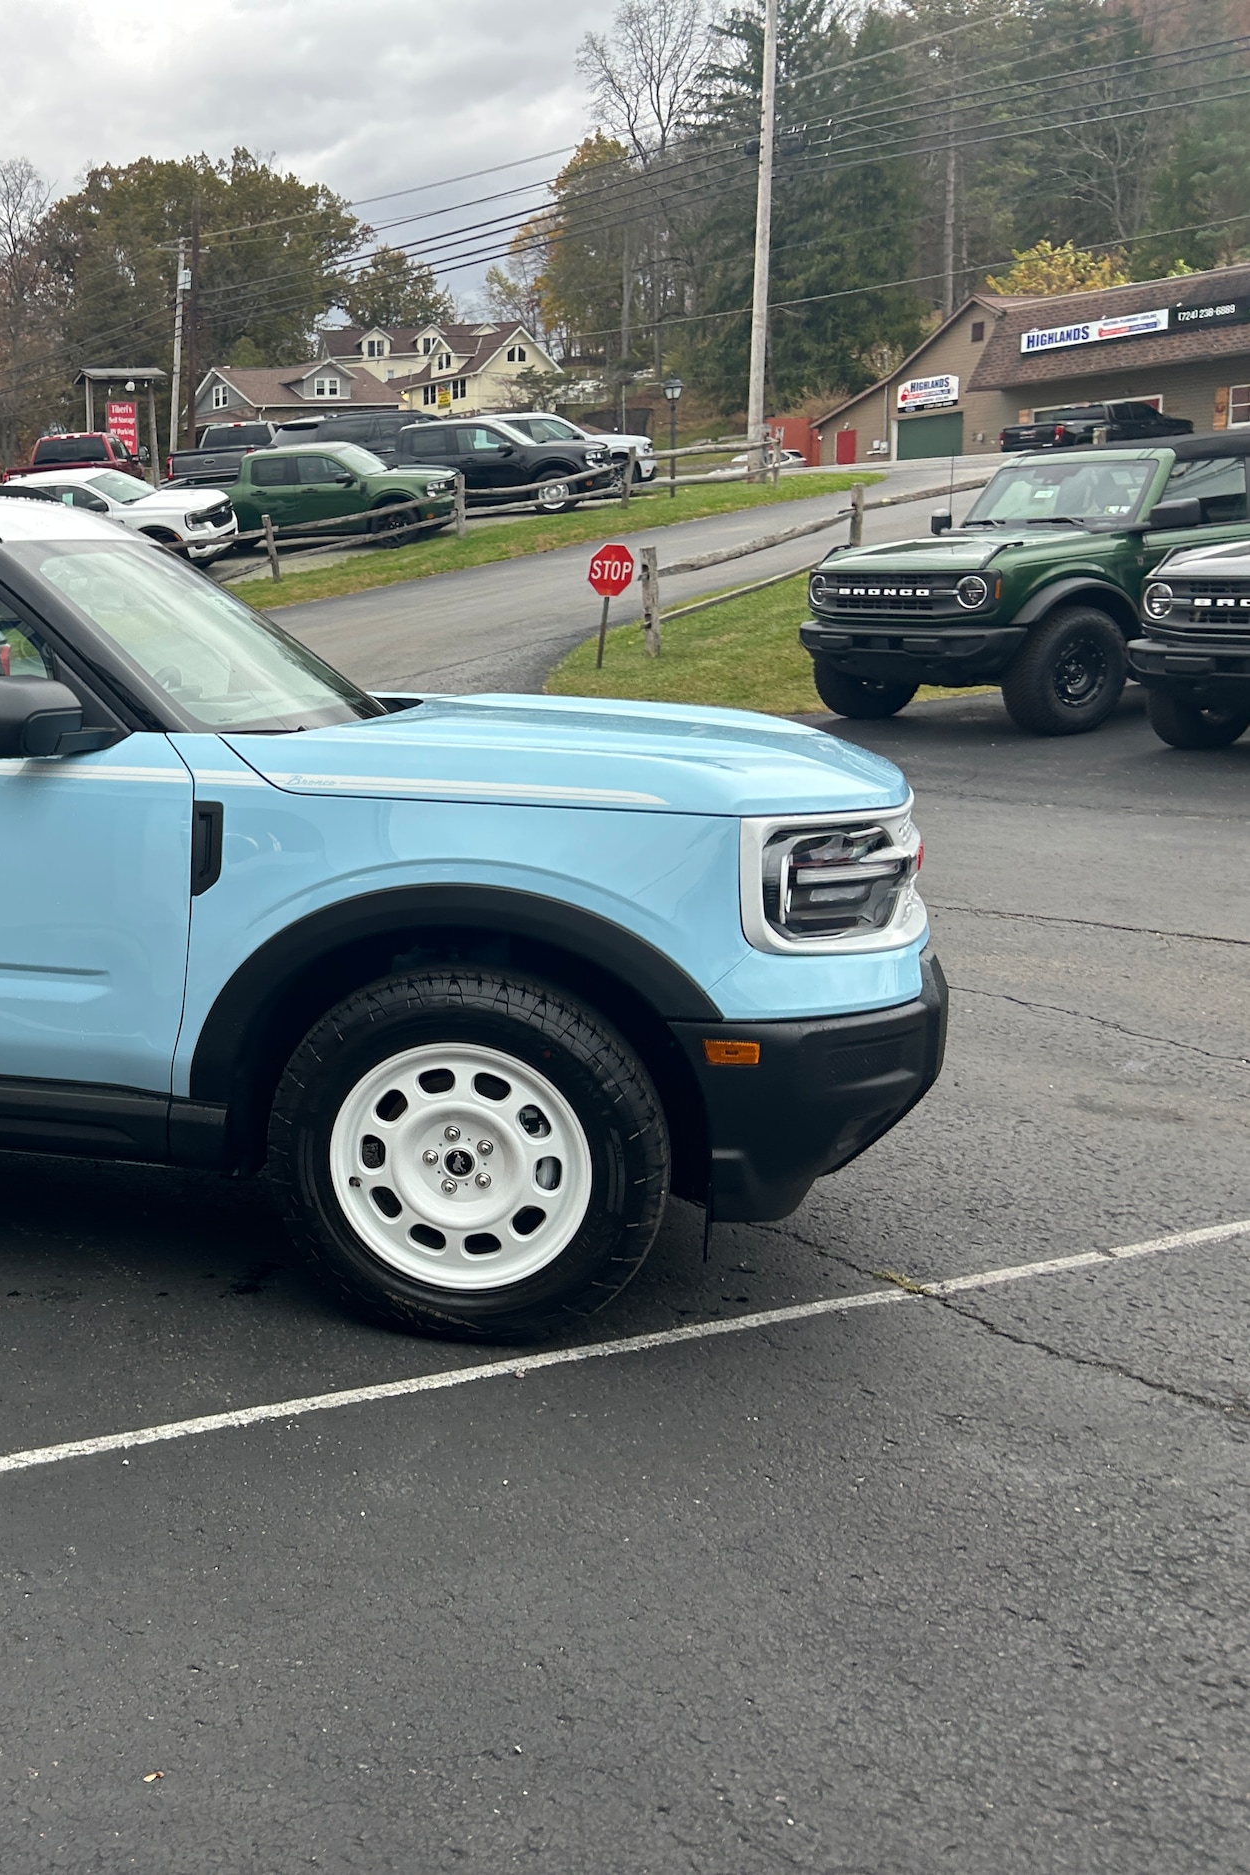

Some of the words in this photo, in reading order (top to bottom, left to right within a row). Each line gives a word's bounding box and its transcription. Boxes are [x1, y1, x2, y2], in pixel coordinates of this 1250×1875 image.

[1026, 325, 1090, 349] HIGHLANDS
[910, 377, 950, 392] HIGHLANDS
[591, 560, 632, 581] STOP
[838, 588, 930, 596] BRONCO
[285, 774, 337, 786] Bronco
